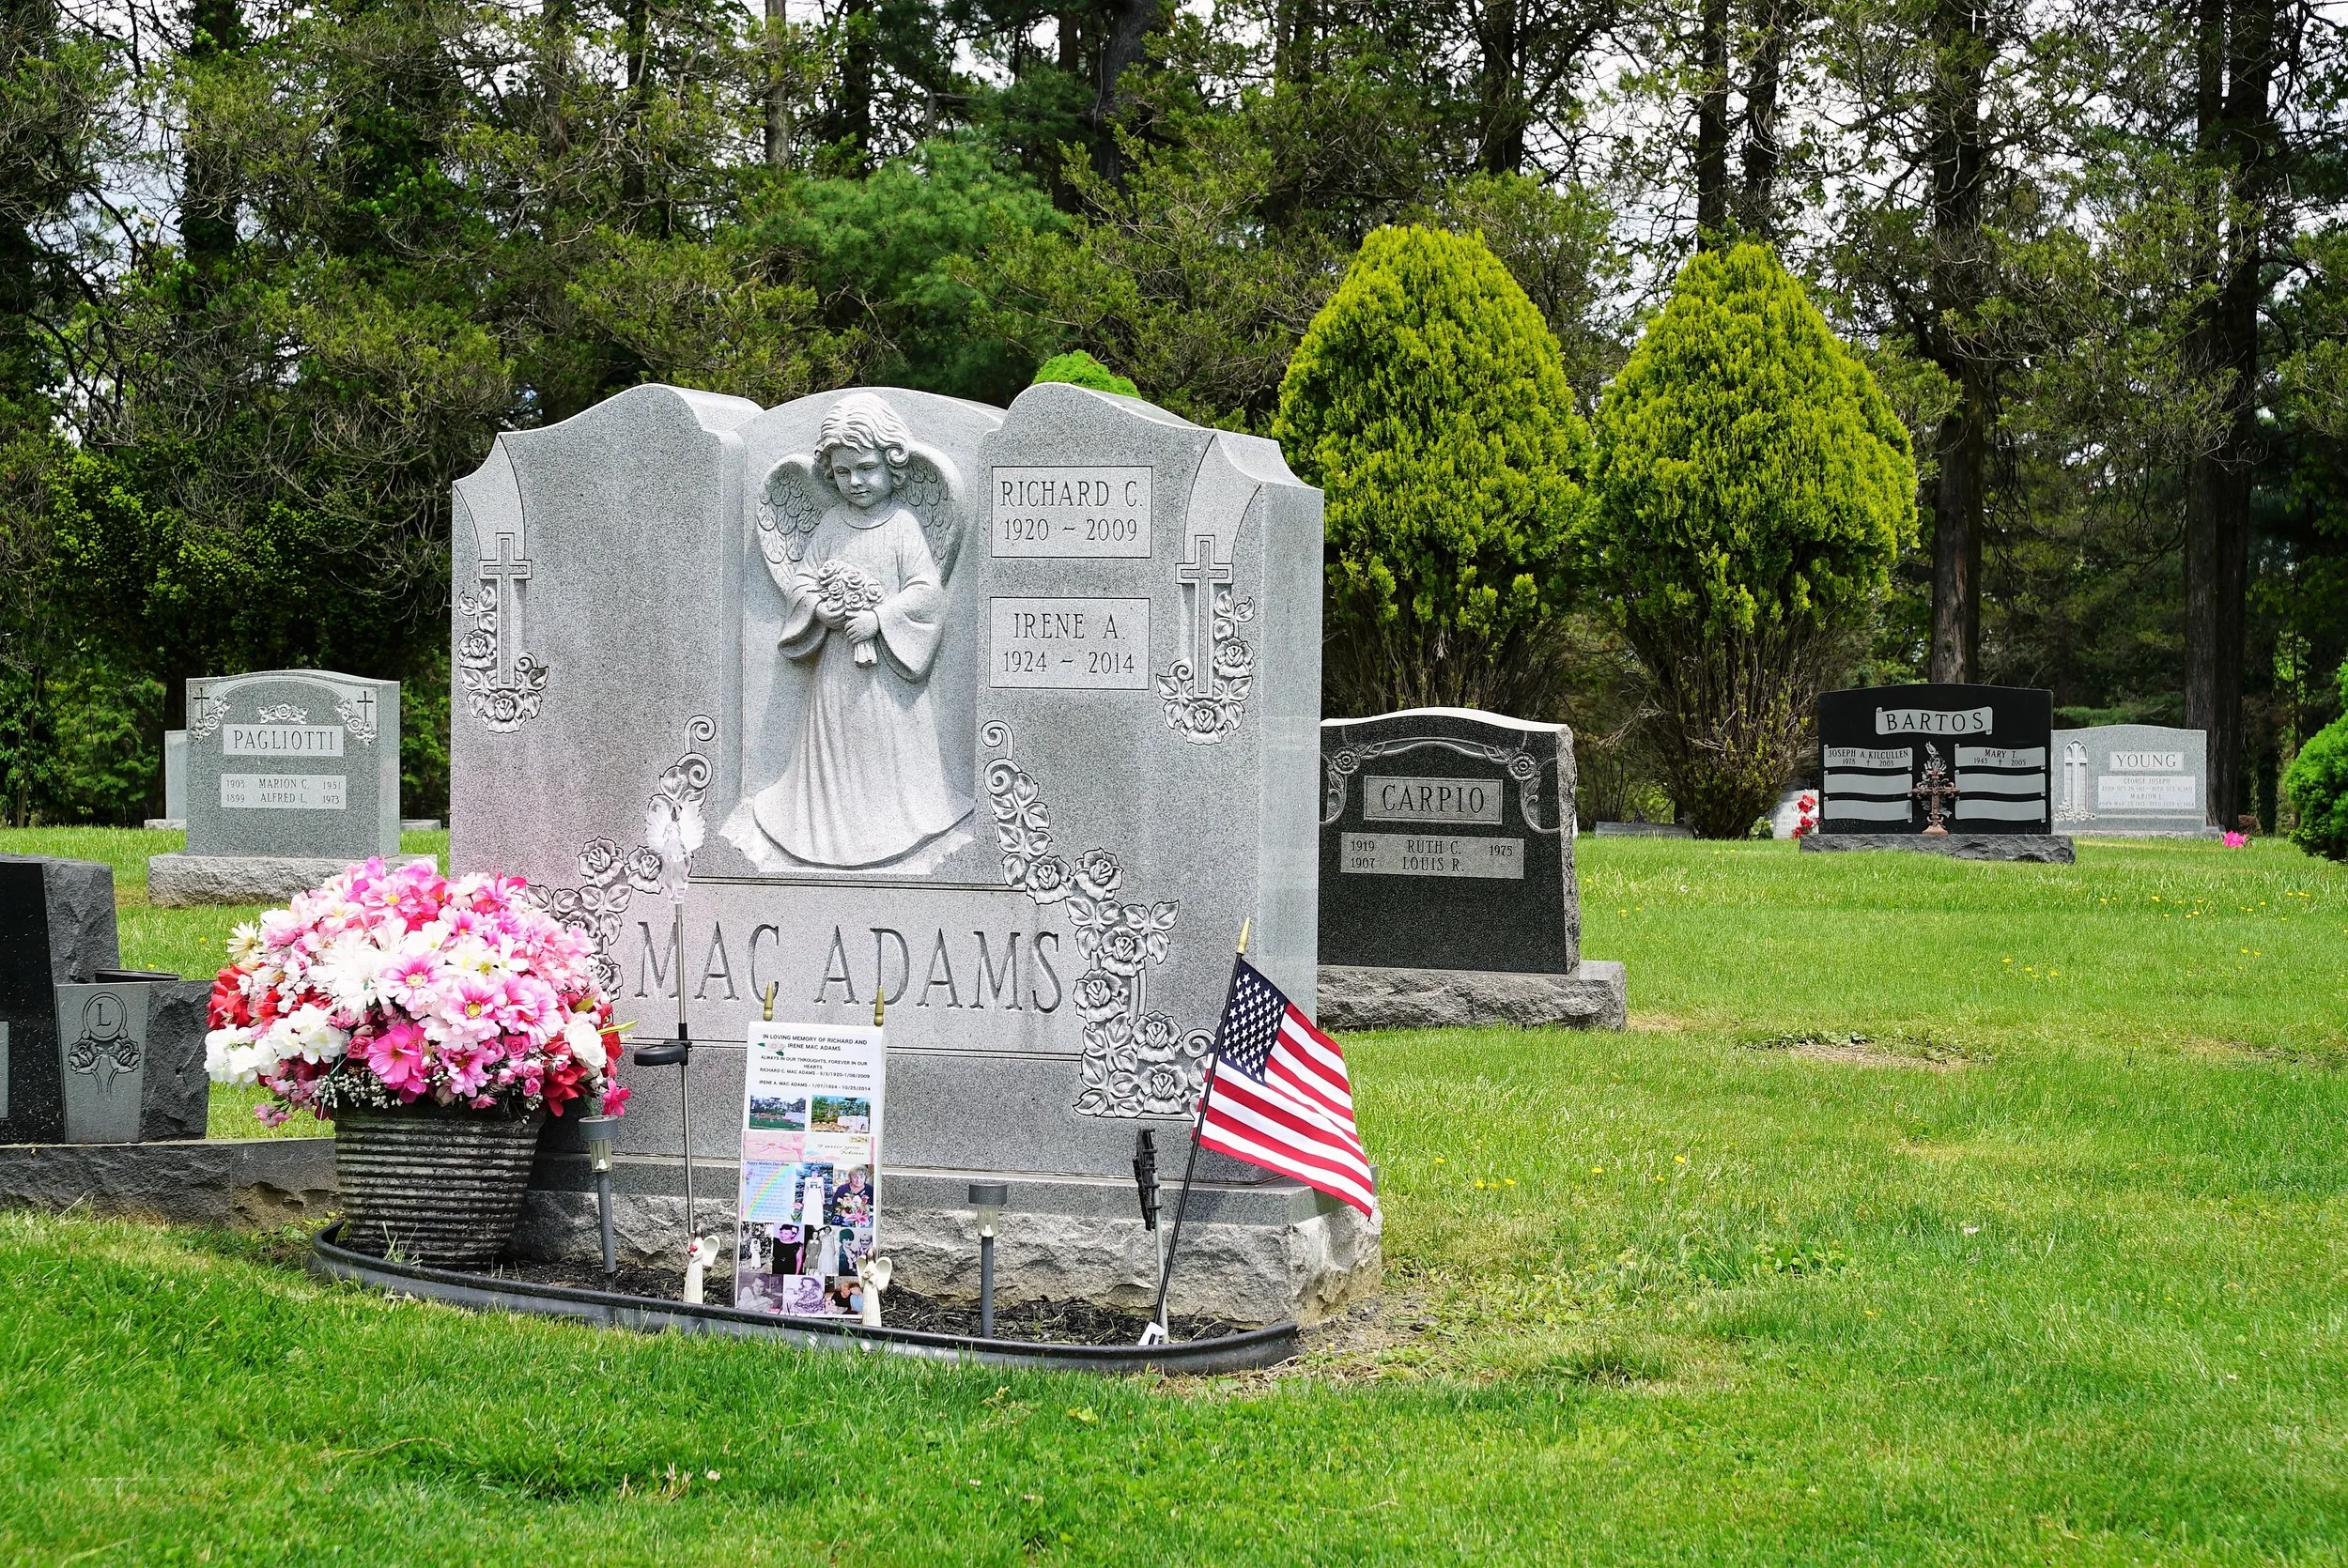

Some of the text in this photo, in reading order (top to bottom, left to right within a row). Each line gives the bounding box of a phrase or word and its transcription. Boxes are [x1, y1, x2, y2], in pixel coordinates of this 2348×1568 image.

[1000, 481, 1143, 507] RICHARD C.
[1004, 518, 1049, 541] 1920
[1086, 518, 1137, 541] 2009
[1013, 613, 1126, 639] IRENE A.
[1003, 651, 1047, 672] 1924
[1089, 652, 1135, 674] 2014
[1886, 712, 1984, 731] BARTOS
[233, 730, 334, 750] PAGLIOTTI
[1828, 748, 1857, 759] JOSEPH
[1868, 748, 1908, 761] KILCULLEN
[1985, 748, 2006, 759] MARY
[2116, 754, 2176, 767] YOUNG
[259, 778, 297, 790] MARION
[301, 778, 310, 790] C.
[260, 793, 296, 804] ALFRED
[1382, 784, 1485, 813] CARPIO
[1351, 839, 1513, 857] 1919 RUTH C. 1975
[1351, 856, 1464, 872] 1907 LOUIS R.
[635, 921, 1062, 1014] MAC ADAMS
[96, 1004, 112, 1027] L
